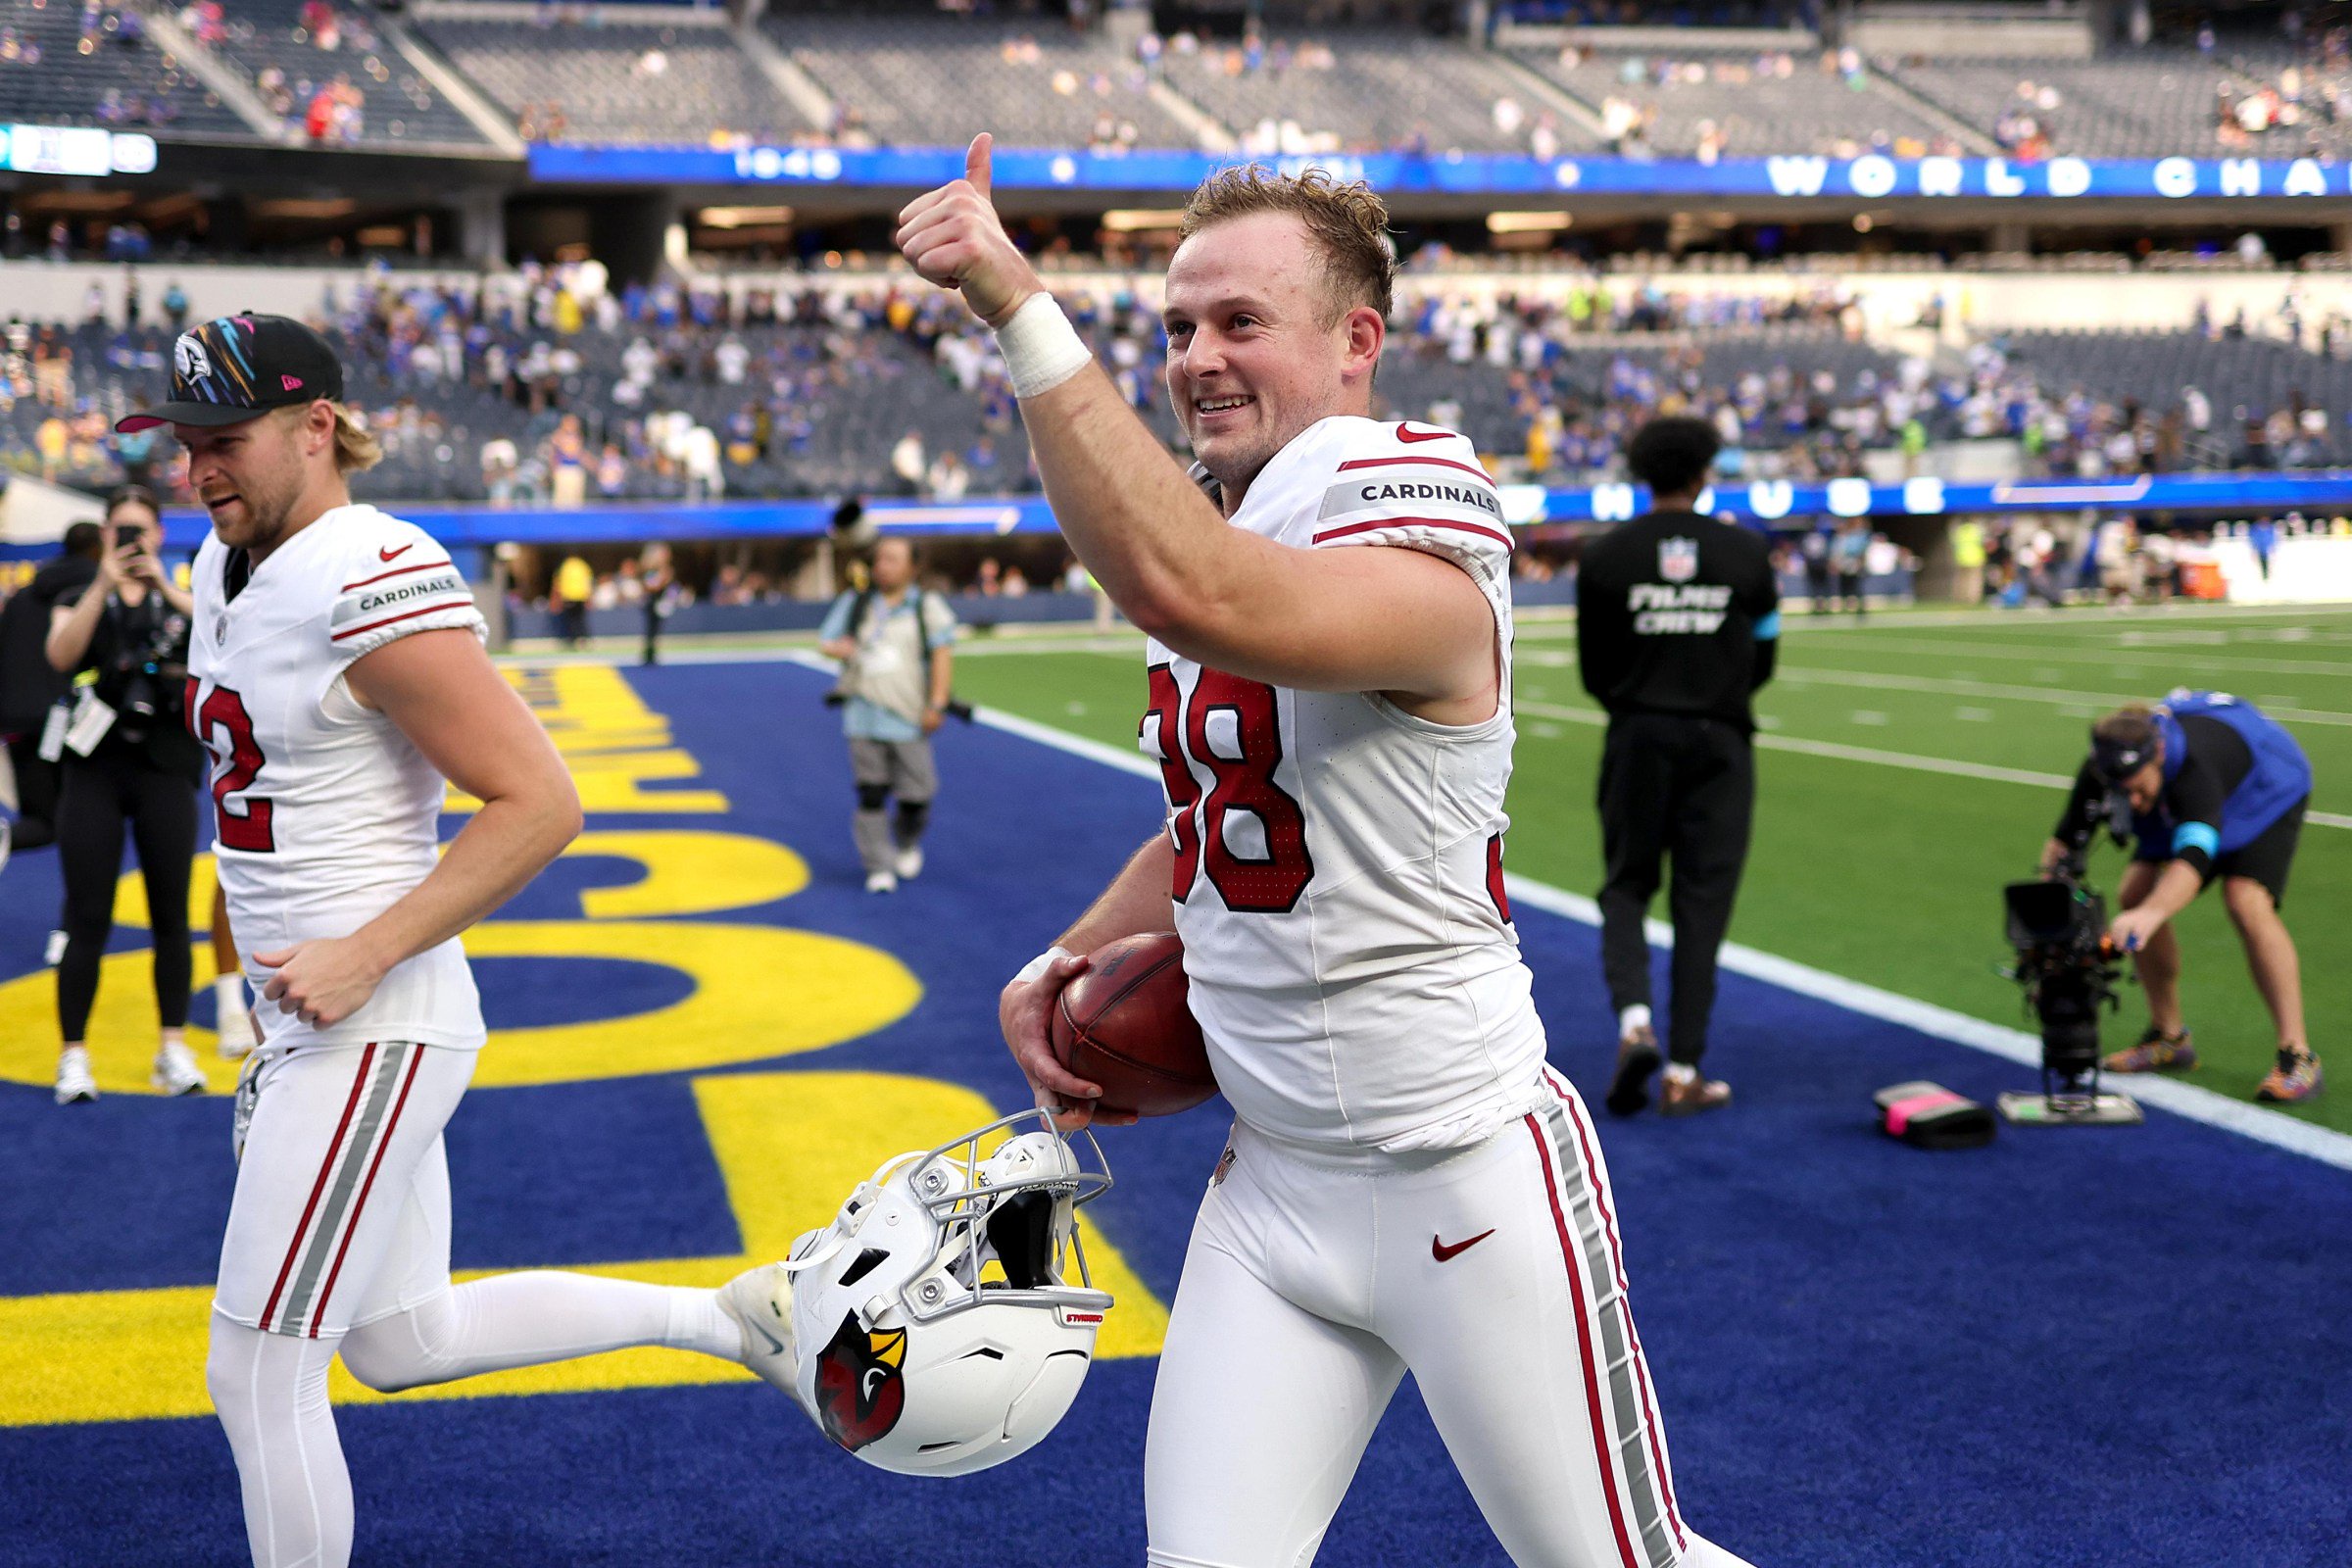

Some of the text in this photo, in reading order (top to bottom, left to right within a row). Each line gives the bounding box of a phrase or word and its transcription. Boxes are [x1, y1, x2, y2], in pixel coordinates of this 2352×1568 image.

[1767, 154, 2352, 197] WORLD CHA
[1361, 483, 1495, 513] CARDINALS
[360, 578, 456, 611] CARDINALS
